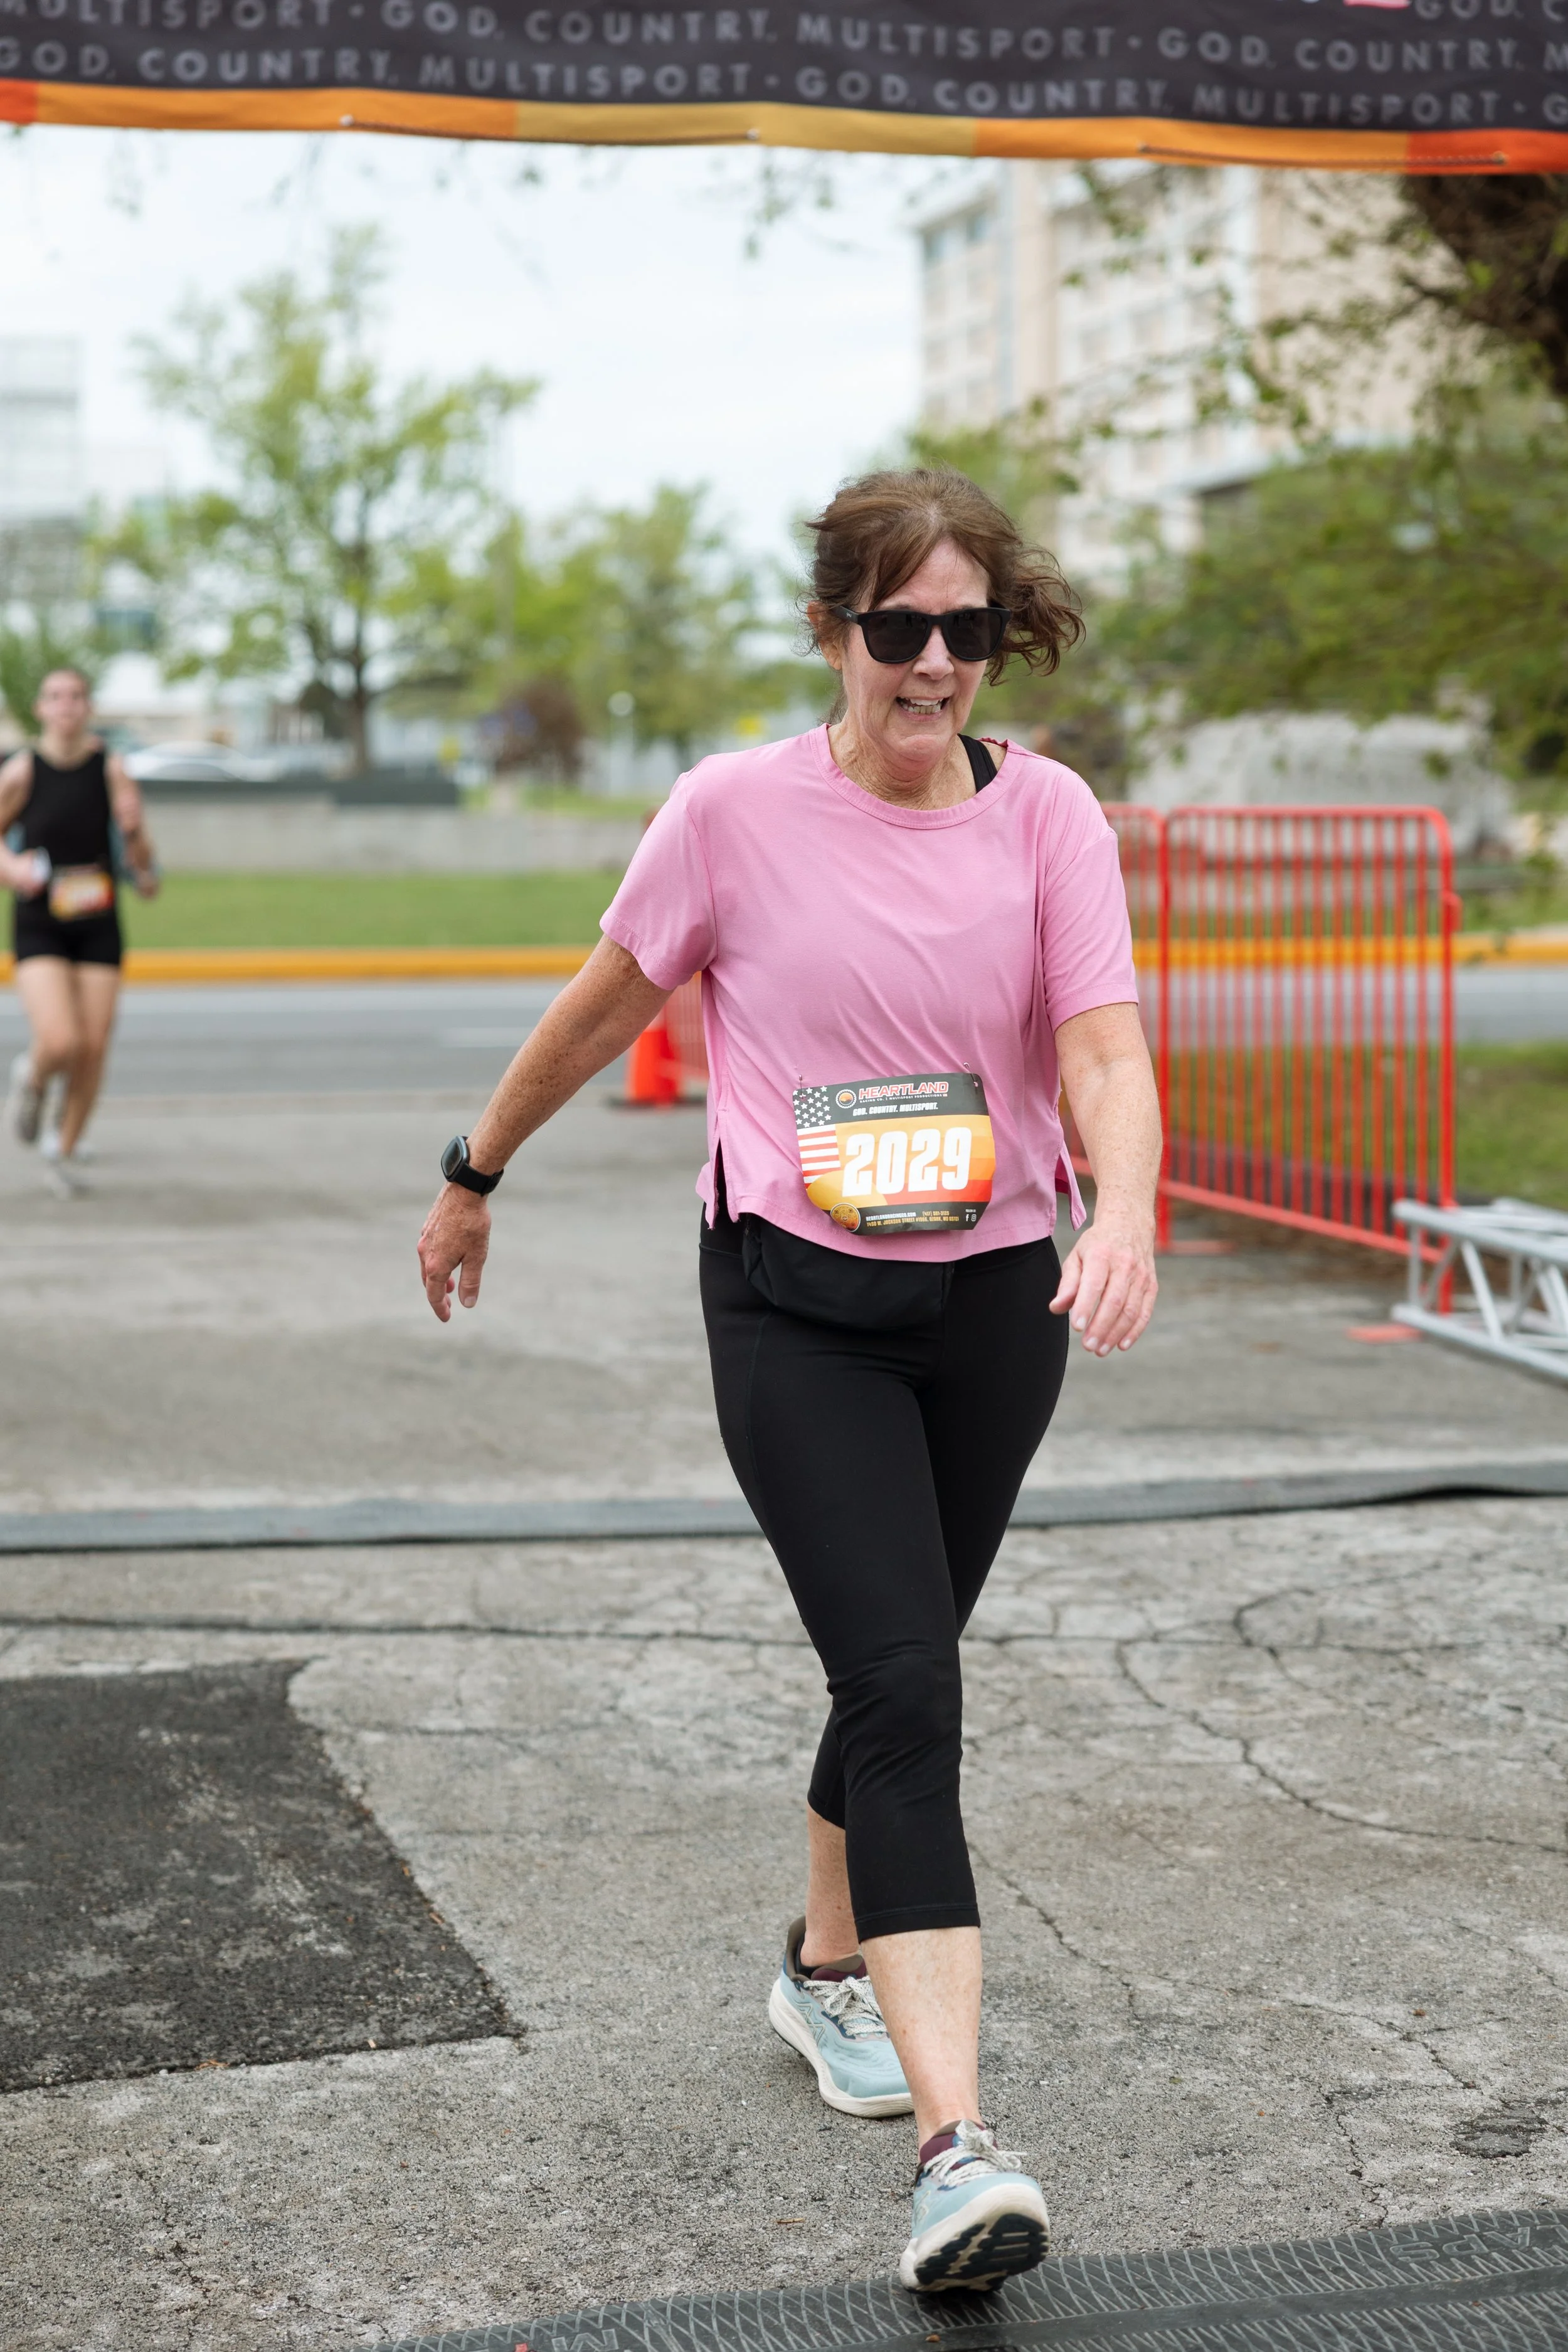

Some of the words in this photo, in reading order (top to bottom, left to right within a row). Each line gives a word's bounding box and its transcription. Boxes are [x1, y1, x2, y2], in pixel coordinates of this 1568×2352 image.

[797, 12, 1116, 61] MULTISPORT
[418, 53, 751, 98] MULTISPORT
[1192, 82, 1500, 125] MULTISPORT
[859, 1081, 949, 1100] HEARTLAND
[842, 1127, 972, 1197] 2029
